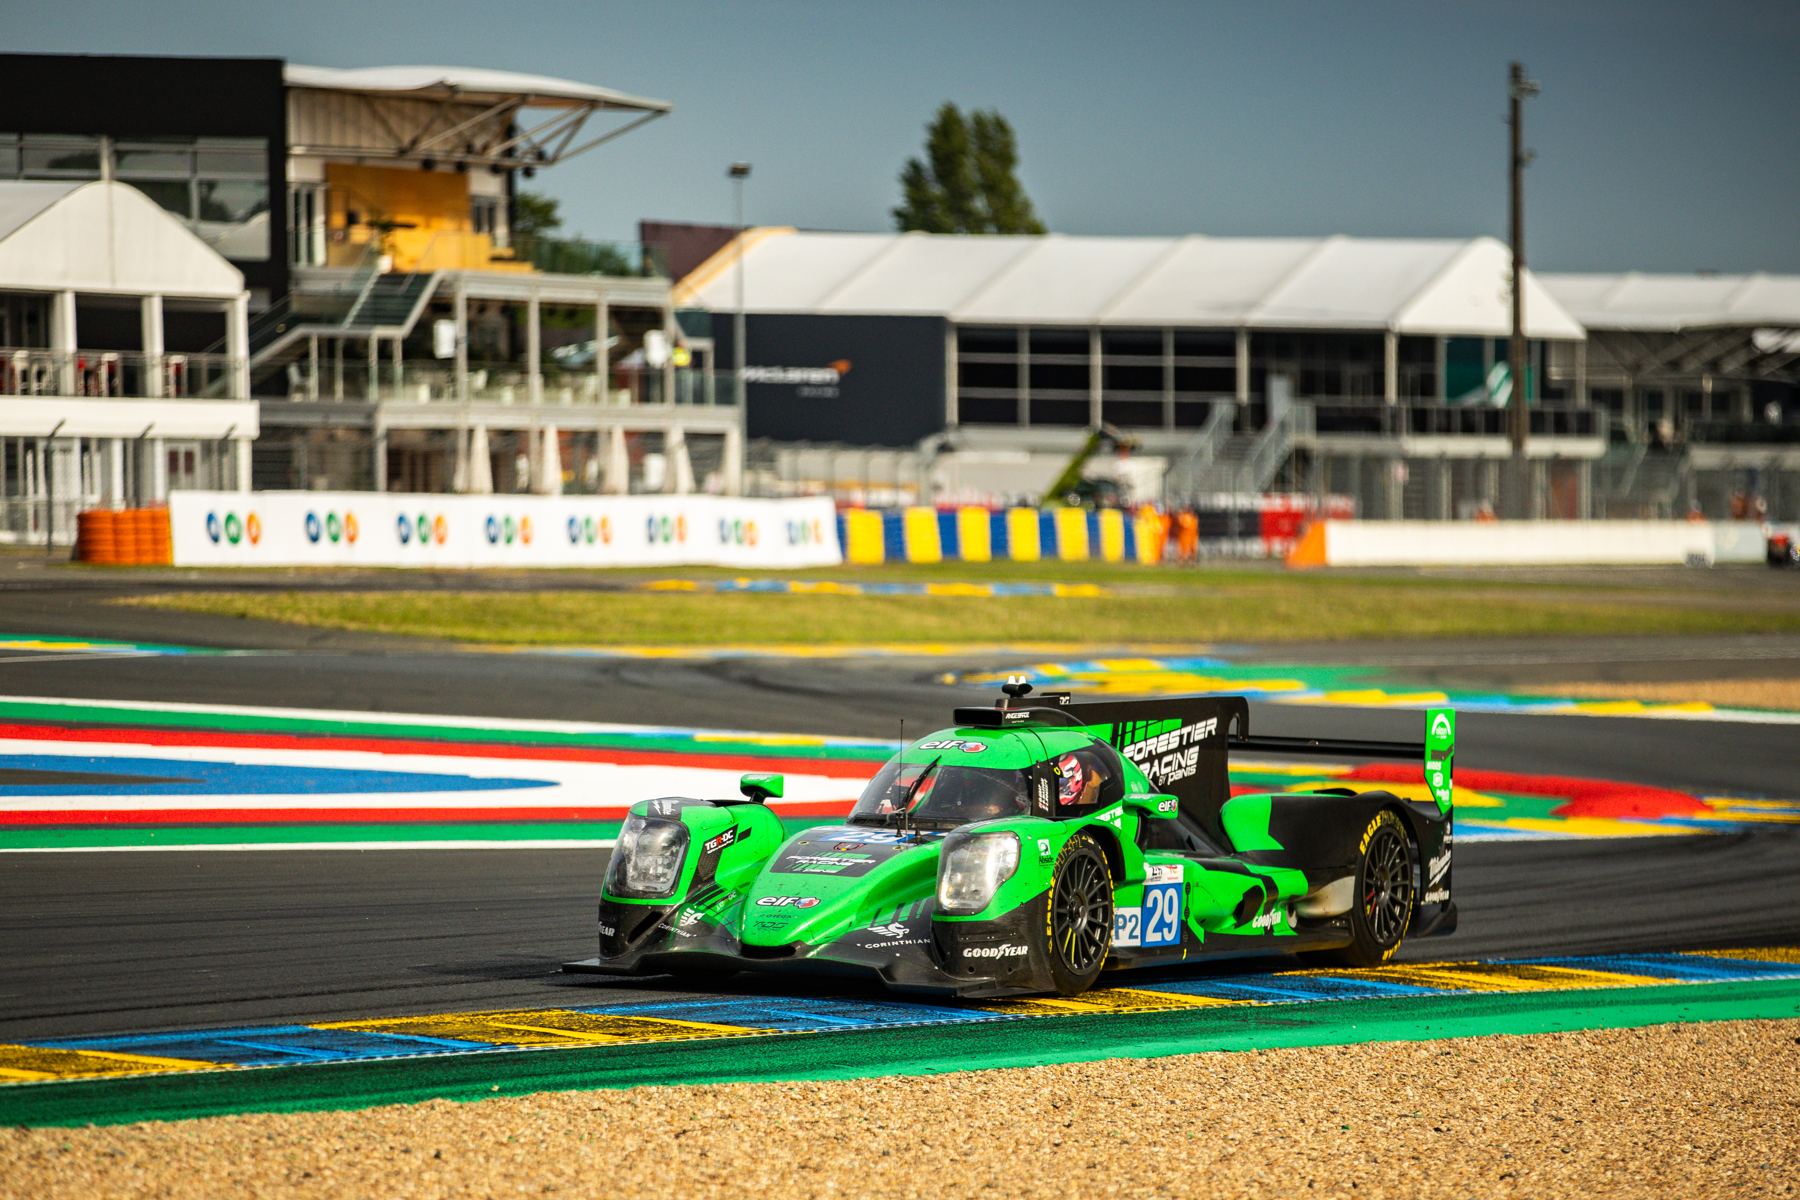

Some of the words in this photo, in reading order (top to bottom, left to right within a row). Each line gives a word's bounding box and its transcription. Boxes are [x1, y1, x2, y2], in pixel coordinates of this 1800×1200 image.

[919, 740, 964, 750] elf
[1123, 717, 1218, 761] FORESTIER
[1139, 745, 1200, 780] RACING
[1158, 801, 1173, 813] elf
[1359, 814, 1382, 856] EAGLE
[756, 897, 800, 906] elf
[1145, 887, 1179, 942] 29
[1114, 913, 1139, 940] P2
[864, 938, 931, 949] CORINTHIAN
[962, 943, 1028, 960] GOODYEAR
